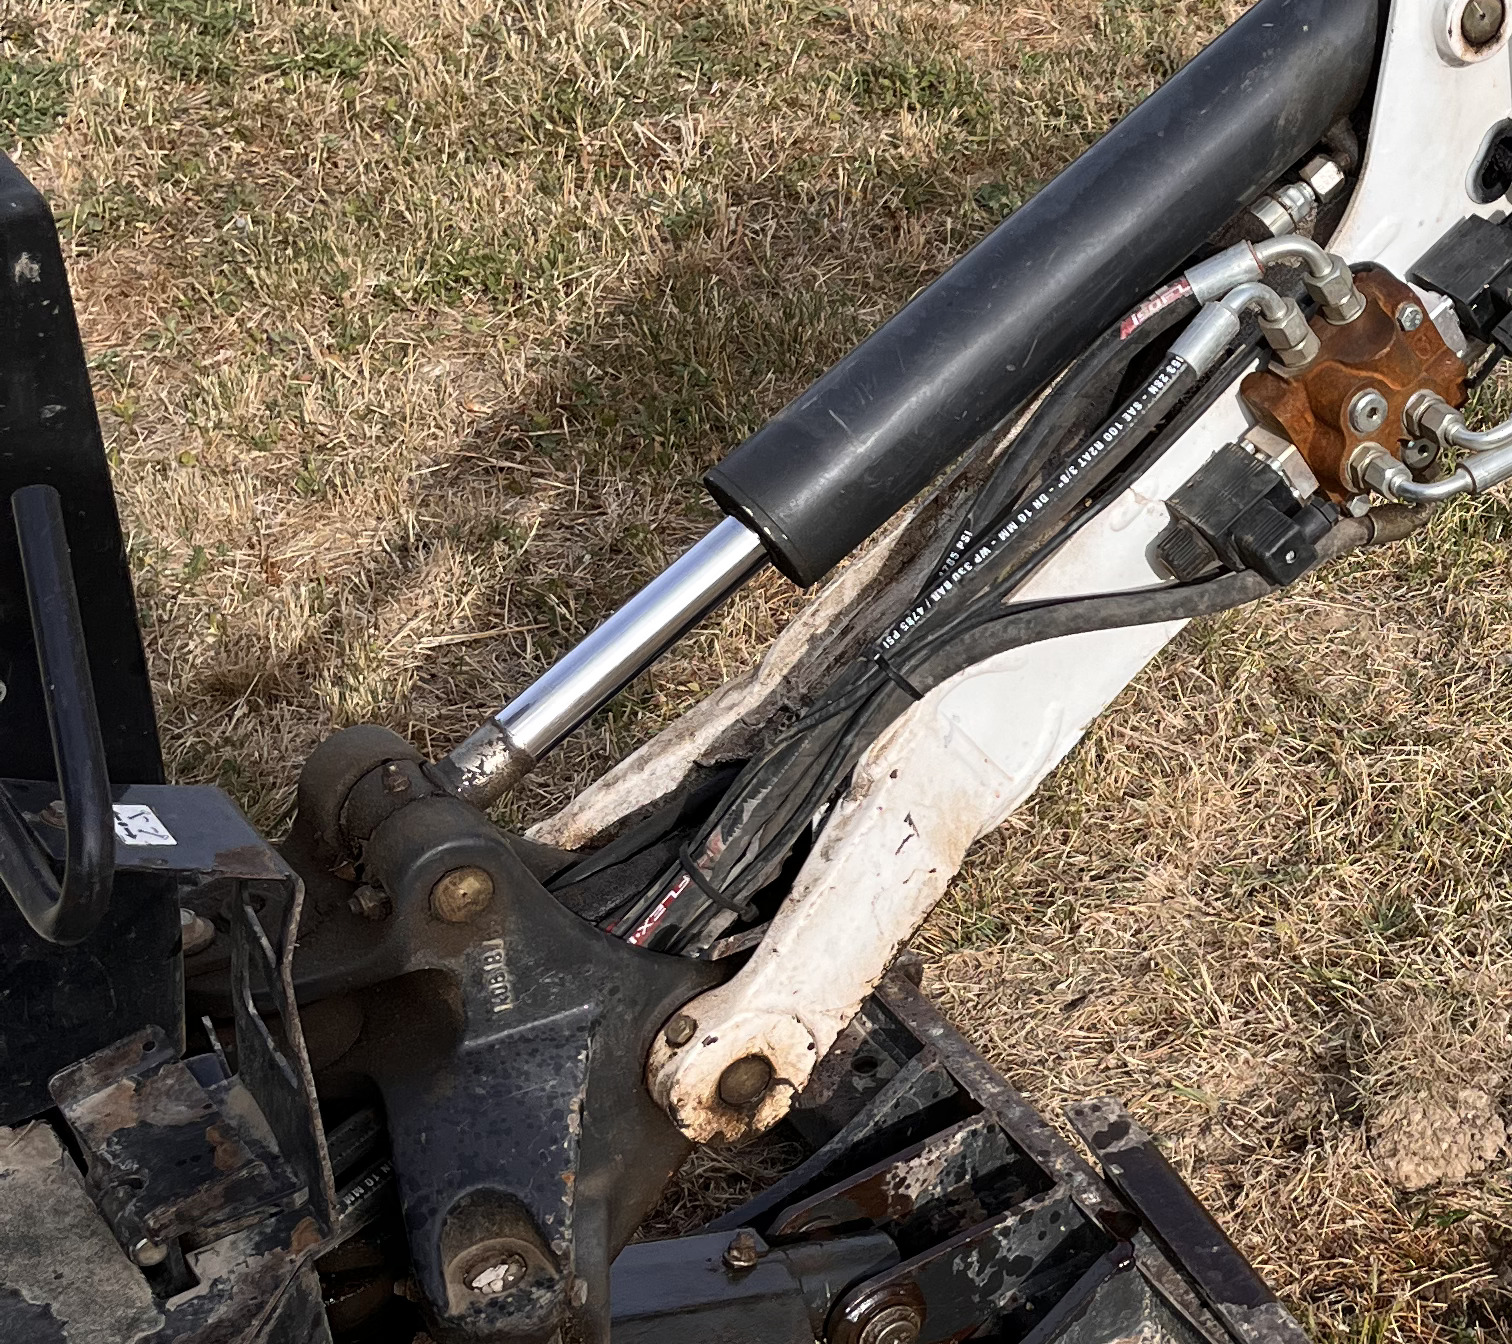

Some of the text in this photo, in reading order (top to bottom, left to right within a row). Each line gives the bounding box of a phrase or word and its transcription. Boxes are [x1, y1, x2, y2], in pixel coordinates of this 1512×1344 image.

[1148, 374, 1169, 395] 2SN
[1122, 402, 1142, 424] SAE
[1103, 423, 1123, 441] 100
[1078, 441, 1104, 467] R2AT
[1059, 466, 1078, 488] 3/8"
[1033, 494, 1049, 509] DN
[1018, 510, 1032, 522] 10
[956, 530, 972, 549] PSI
[998, 522, 1018, 540] MM
[975, 547, 991, 563] WP
[931, 581, 952, 601] BAR
[900, 607, 924, 631] 4785
[881, 629, 900, 649] PSI
[364, 1174, 380, 1187] 10
[343, 1185, 365, 1205] MM
